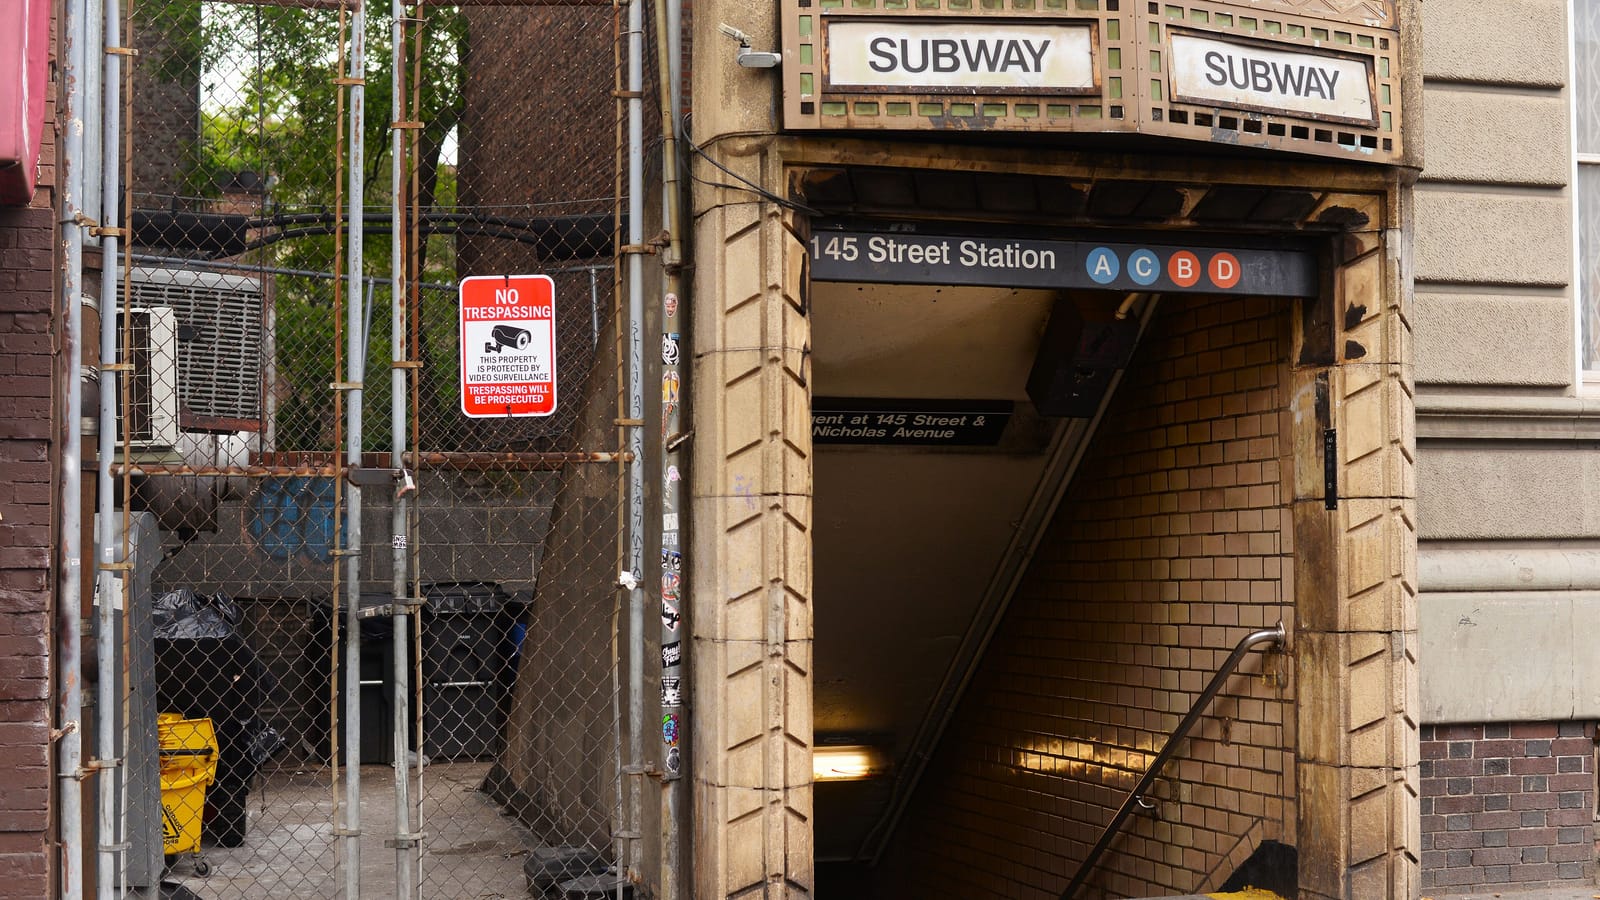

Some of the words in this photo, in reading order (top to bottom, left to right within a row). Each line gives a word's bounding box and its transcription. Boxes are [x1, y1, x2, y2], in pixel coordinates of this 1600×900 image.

[869, 37, 1051, 73] SUBWAY
[1204, 51, 1340, 101] SUBWAY
[811, 235, 859, 262] 145
[867, 236, 951, 265] Street
[958, 239, 1056, 270] Station
[1094, 254, 1112, 275] A
[1136, 256, 1153, 277] C
[1177, 258, 1194, 279] B
[1217, 259, 1234, 280] D
[495, 288, 519, 304] NO
[464, 306, 551, 319] TRESPASSING
[498, 355, 537, 363] PROPERTY
[486, 365, 530, 373] PROTECTED
[530, 364, 541, 372] BY
[469, 374, 492, 382] VIDEO
[493, 373, 549, 381] SURVEILLANCE
[468, 386, 528, 395] TRESPASSING
[529, 385, 550, 394] WILL
[474, 396, 486, 404] BE
[487, 395, 544, 404] PROSECUTED
[850, 414, 869, 425] at
[876, 414, 906, 425] 145
[912, 414, 967, 426] Street
[972, 415, 986, 426] &
[812, 426, 887, 437] Nicholas
[892, 427, 955, 438] Avenue
